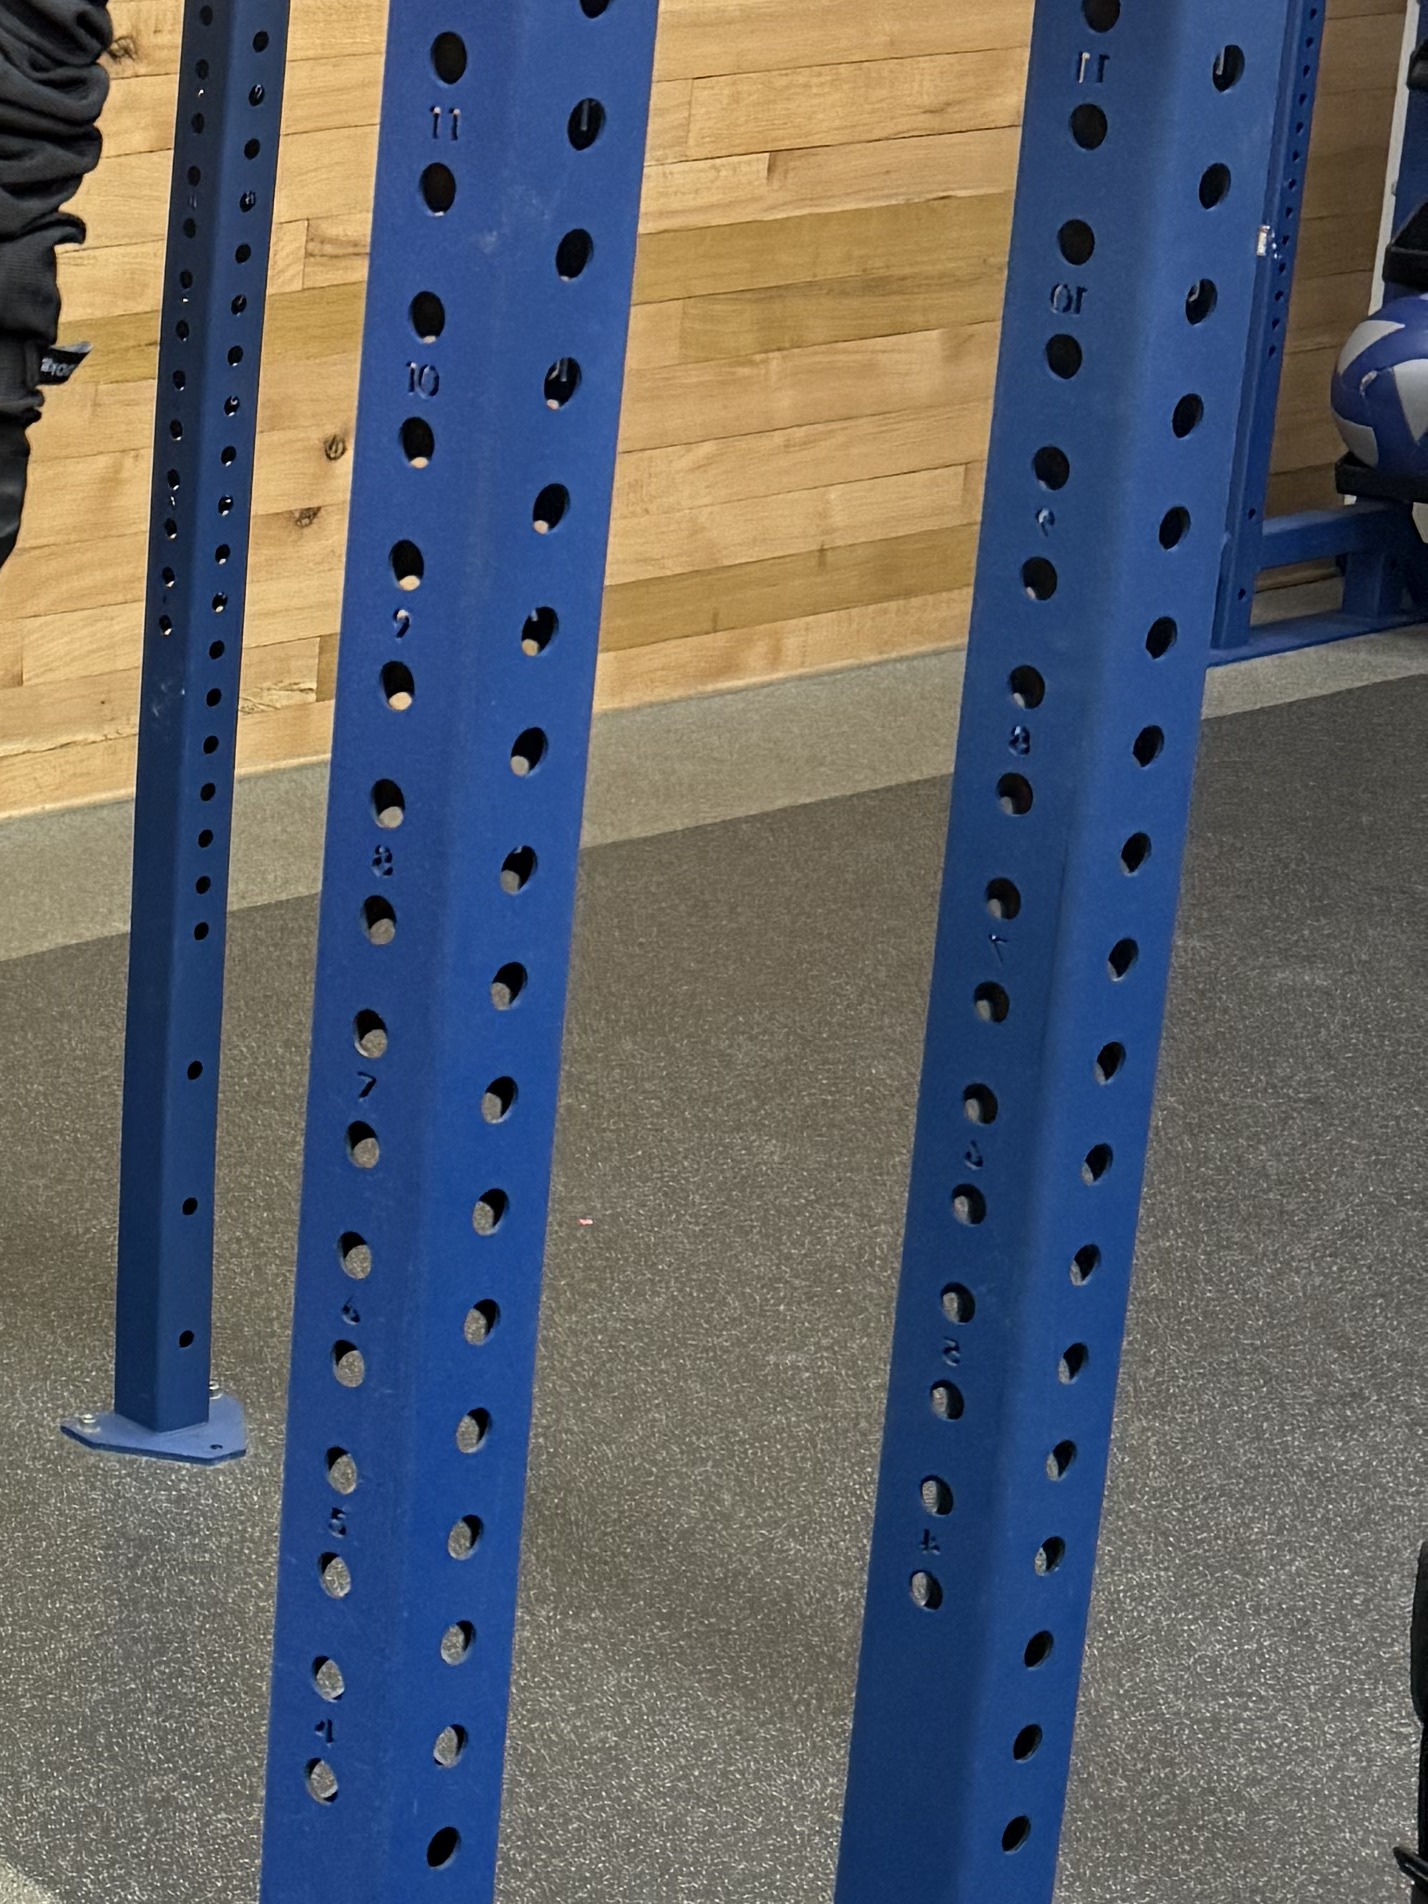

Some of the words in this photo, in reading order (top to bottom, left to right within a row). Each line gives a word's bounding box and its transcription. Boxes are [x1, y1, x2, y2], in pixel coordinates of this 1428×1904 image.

[430, 105, 461, 141] 11
[405, 361, 440, 398] 10
[392, 608, 410, 639] 9
[357, 1071, 377, 1102] 7
